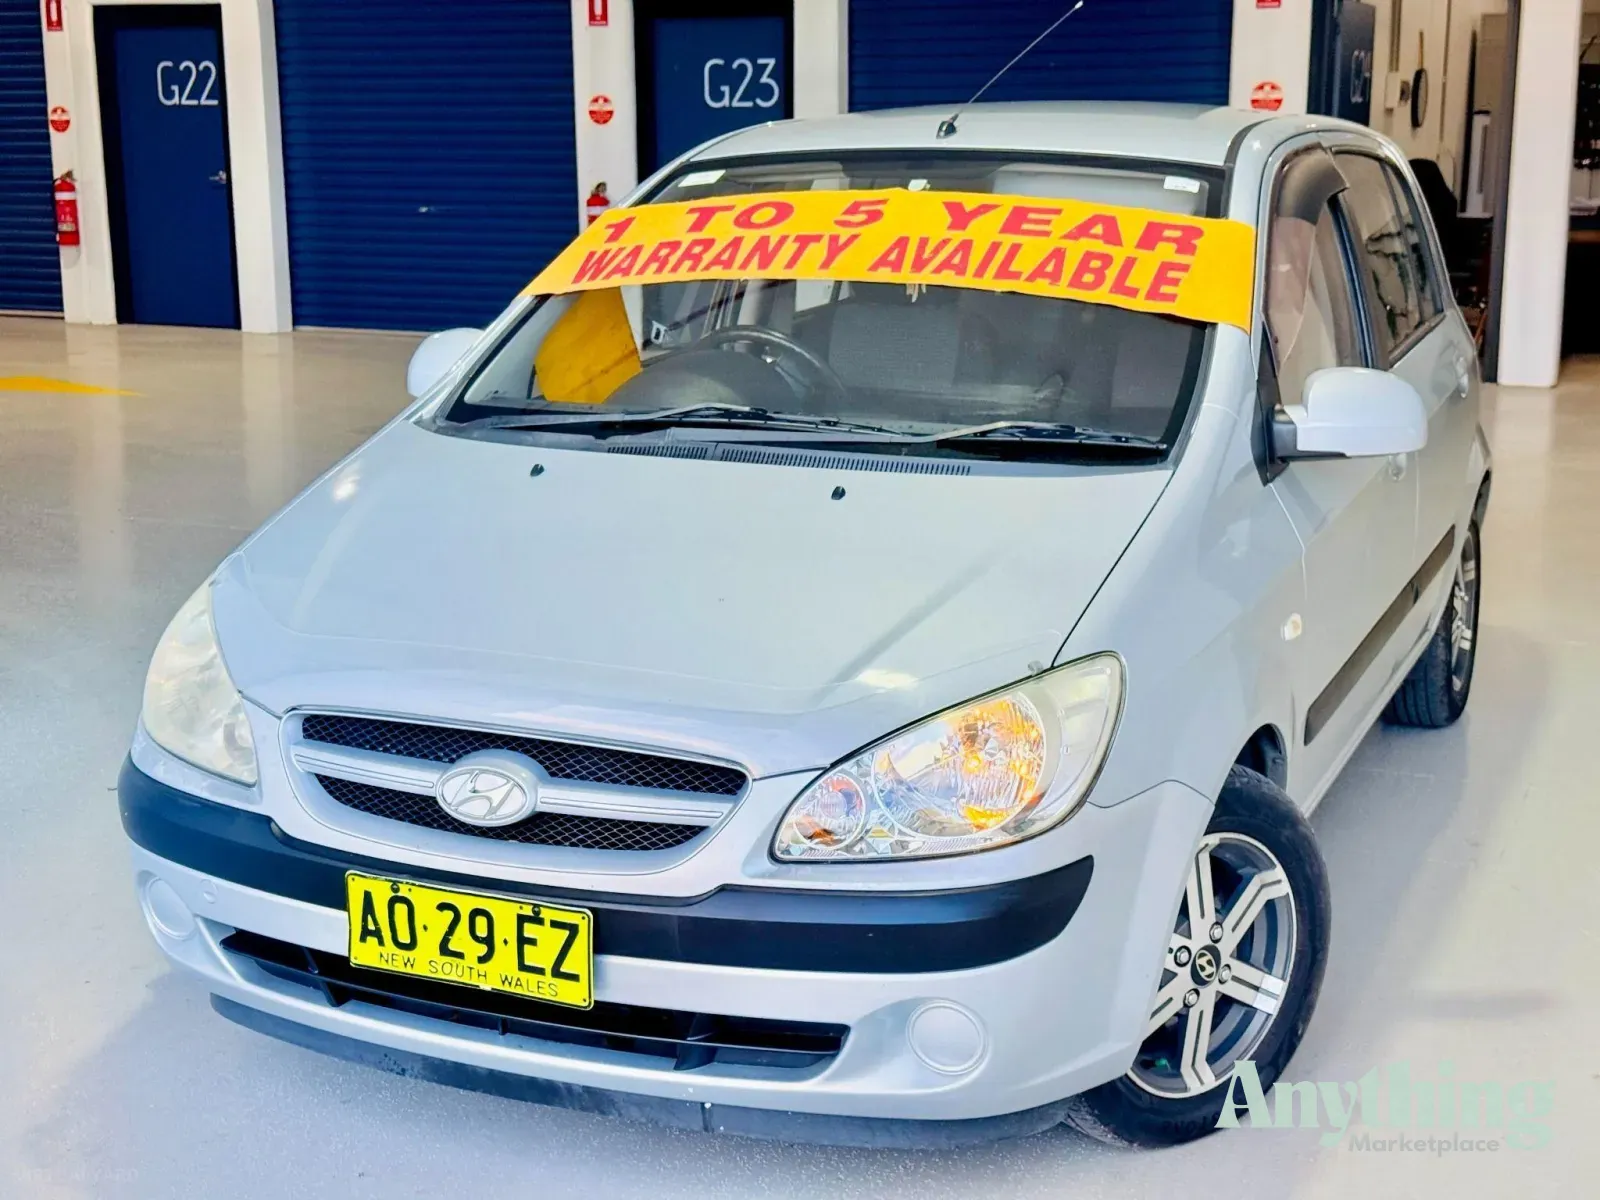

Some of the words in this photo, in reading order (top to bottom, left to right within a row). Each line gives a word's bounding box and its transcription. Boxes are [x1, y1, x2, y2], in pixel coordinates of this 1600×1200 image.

[156, 60, 219, 106] G22
[704, 58, 779, 108] G23
[605, 216, 635, 243] 1
[687, 201, 794, 233] TO
[835, 199, 887, 228] 5
[944, 201, 1204, 256] YEAR
[573, 234, 860, 284] WARRANTY
[868, 236, 1190, 302] AVAILABLE
[380, 952, 416, 970] NEW
[429, 959, 487, 982] SOUTH
[500, 973, 558, 997] WALES
